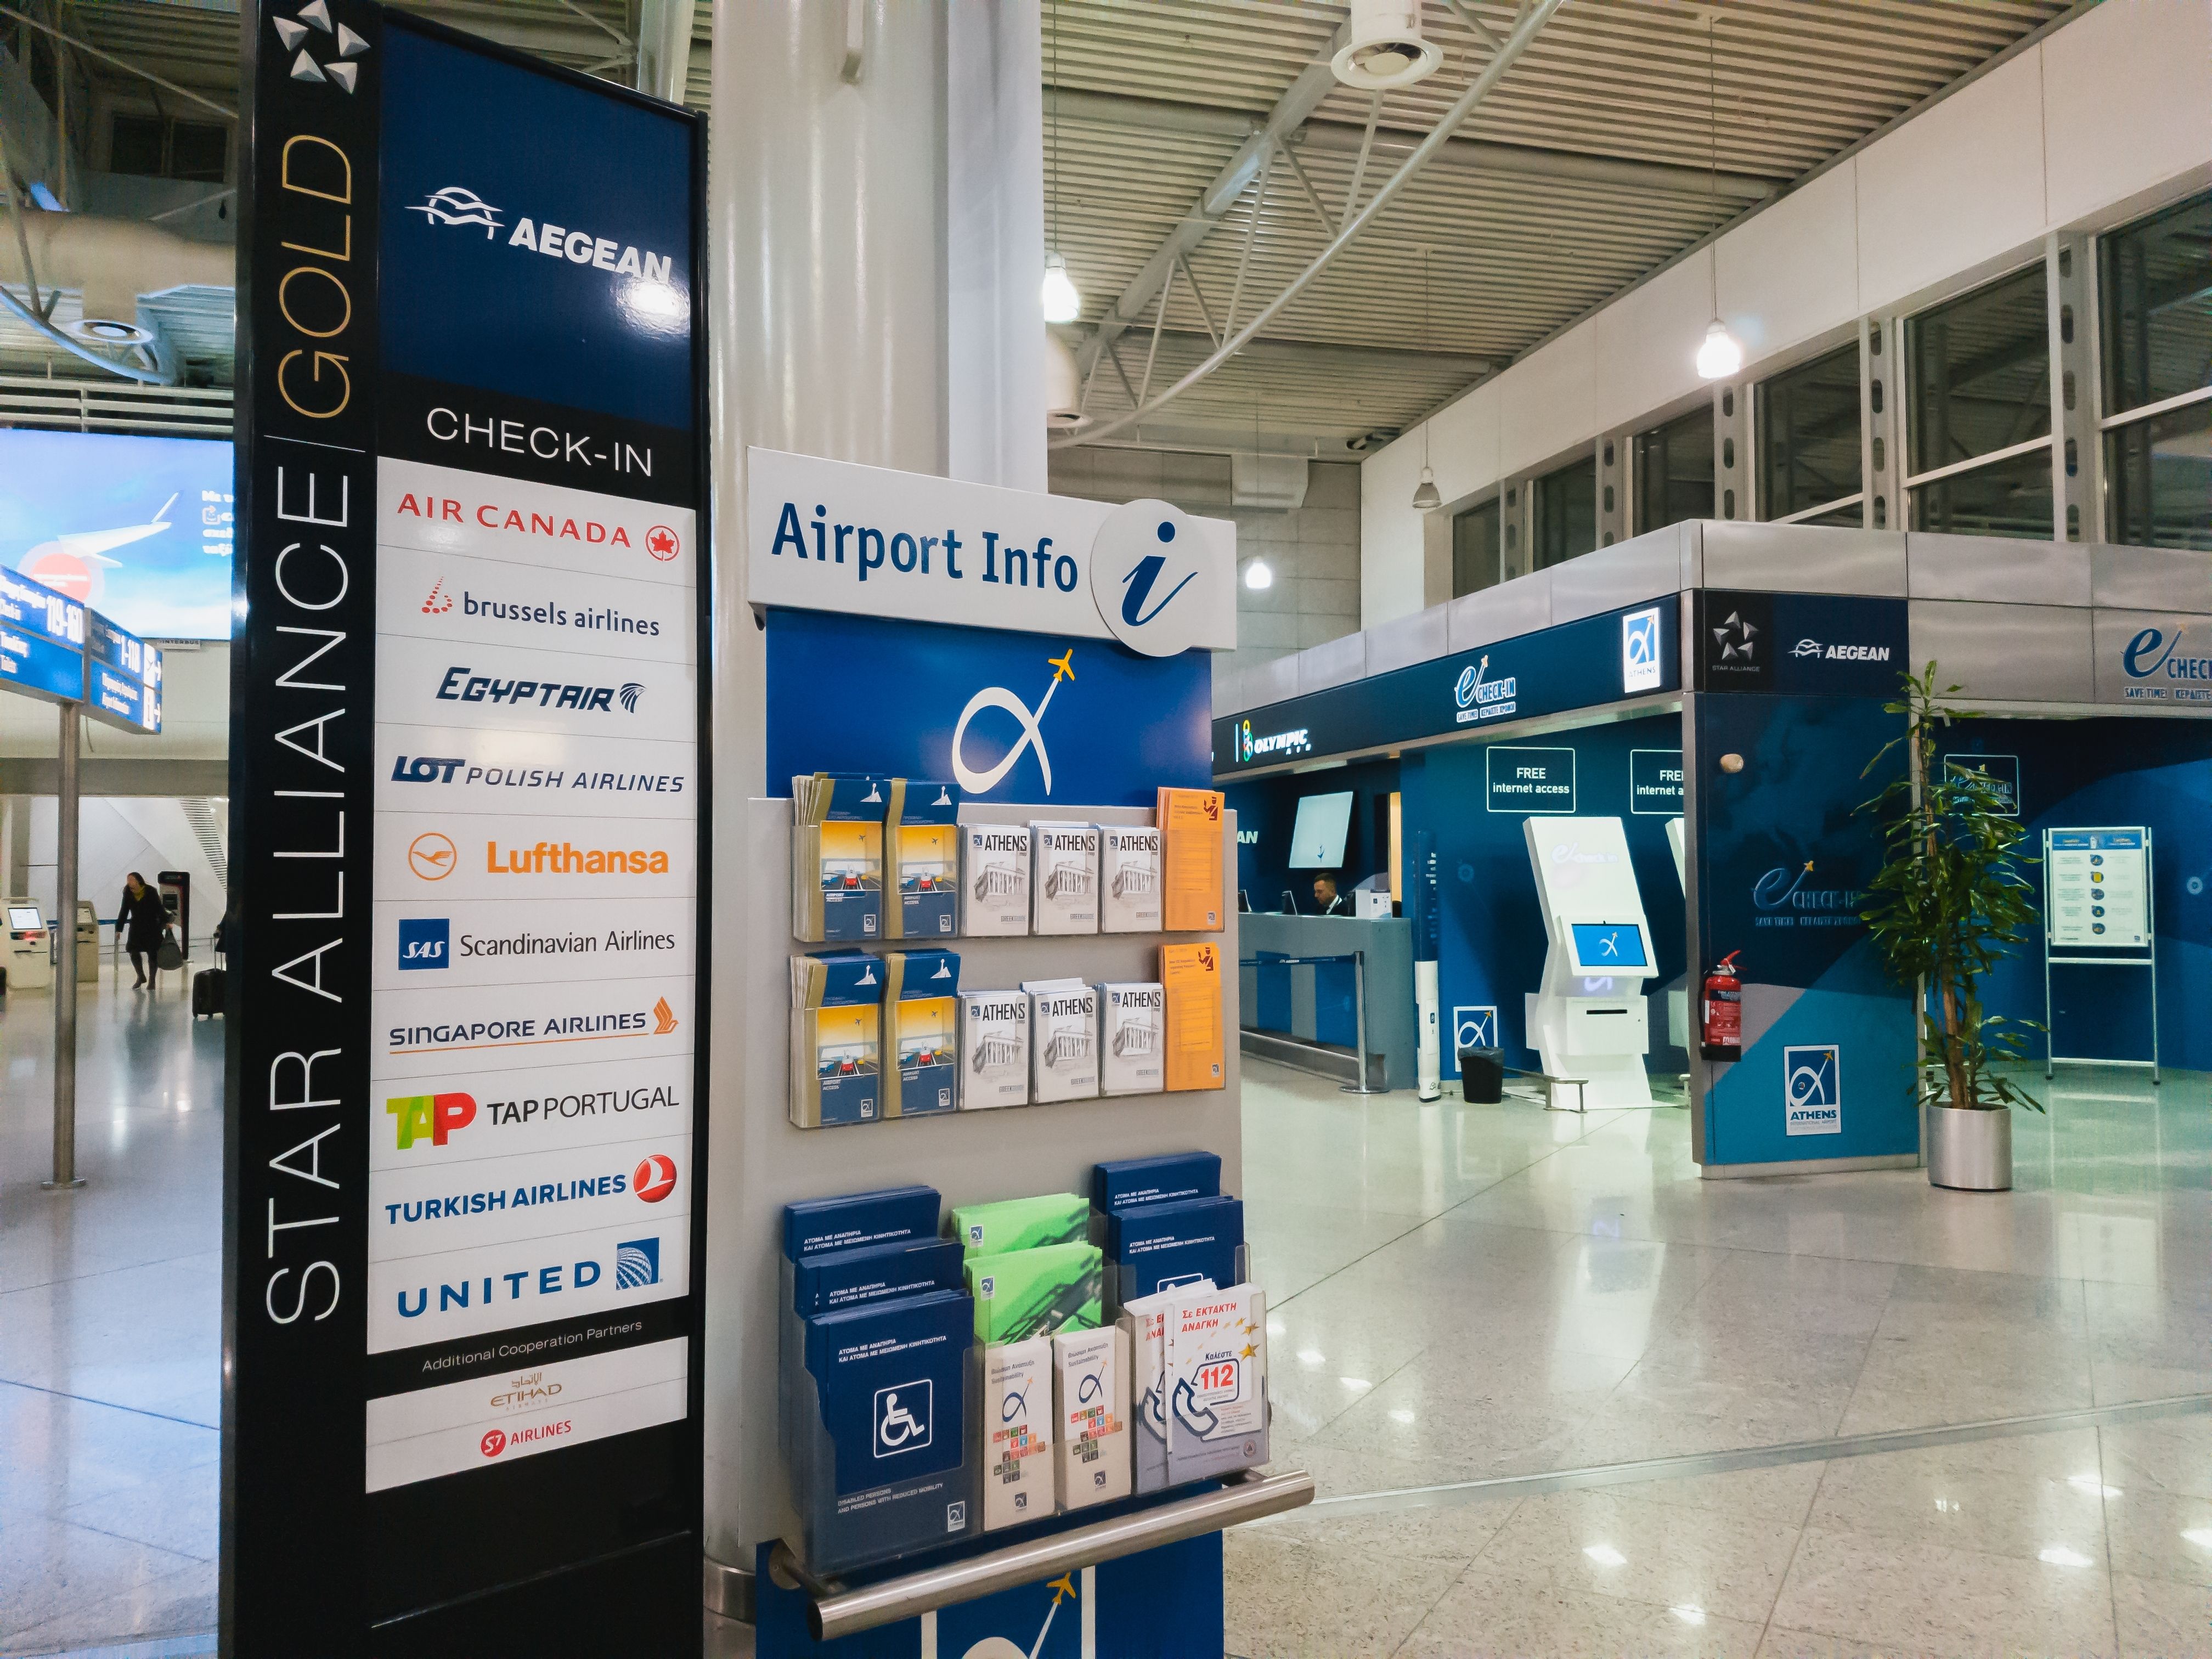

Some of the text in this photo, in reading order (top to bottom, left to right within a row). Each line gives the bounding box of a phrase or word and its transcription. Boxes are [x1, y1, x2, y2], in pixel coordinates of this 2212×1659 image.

[509, 218, 672, 284] AEGEAN
[278, 134, 351, 418] GOLD
[427, 407, 652, 477] CHECK-IN
[397, 493, 631, 549] AIR CANADA
[771, 502, 963, 582] Airport
[981, 531, 1079, 593] Info
[464, 591, 659, 636] brussels airlines
[1825, 645, 1889, 661] AEGEAN
[1628, 666, 1656, 678] ATHENS
[2125, 687, 2144, 698] SAVE
[1254, 729, 1308, 754] OLYMPIC
[390, 755, 685, 793] LOT POLISH AIRLINES
[1516, 768, 1546, 779] FREE
[1493, 782, 1570, 794] internet access
[1637, 785, 1675, 795] internet
[985, 834, 1028, 851] ATHENS
[1054, 834, 1095, 851] ATHENS
[1120, 836, 1159, 852] ATHENS
[487, 841, 669, 874] Lufthansa
[266, 466, 348, 1325] STAR ALLIANCE
[402, 930, 675, 960] SAS Scandinavian Airlines
[1052, 996, 1093, 1018] ATHENS
[1121, 991, 1161, 1008] ATHENS
[983, 1002, 1026, 1022] ATHENS
[389, 1013, 646, 1046] SINGAPORE AIRLINES
[386, 1086, 680, 1150] TAP TAP PORTUGAL
[1791, 1109, 1837, 1120] ATHENS
[385, 1173, 627, 1225] TURKISH AIRLINES
[833, 1230, 861, 1239] ΑΝΑΠΗΡΙΑ
[814, 1242, 833, 1250] ΑΤΟΜΑ
[397, 1260, 602, 1318] UNITED
[859, 1282, 885, 1291] ΑΝΑΠΗΡΙΑ
[839, 1294, 858, 1302] ΑΤΟΜΑ
[1182, 1302, 1237, 1319] Σε ΕΚΤΑΚΤΗ
[1181, 1319, 1219, 1333] ΑΝΑΓΚΗ
[422, 1321, 642, 1372] Additional Cooperation Partners
[838, 1347, 859, 1355] ΑΤΟΜΑ
[869, 1338, 896, 1349] ΑΝΑΠΗΡΙΑ
[1205, 1350, 1233, 1361] Καλέστε
[849, 1352, 869, 1361] ΑΤΟΜΑ
[1068, 1355, 1099, 1368] Sustainability
[991, 1372, 1024, 1384] Sustainability
[1201, 1364, 1234, 1390] 112
[490, 1383, 563, 1407] ETIHAD
[484, 1420, 572, 1454] S7 AIRLINES
[838, 1488, 891, 1506] DISABLED PERSONS
[850, 1499, 876, 1510] PERSONS
[877, 1496, 891, 1504] WITH
[892, 1489, 918, 1500] REDUCED
[918, 1482, 944, 1493] MOBILITY
